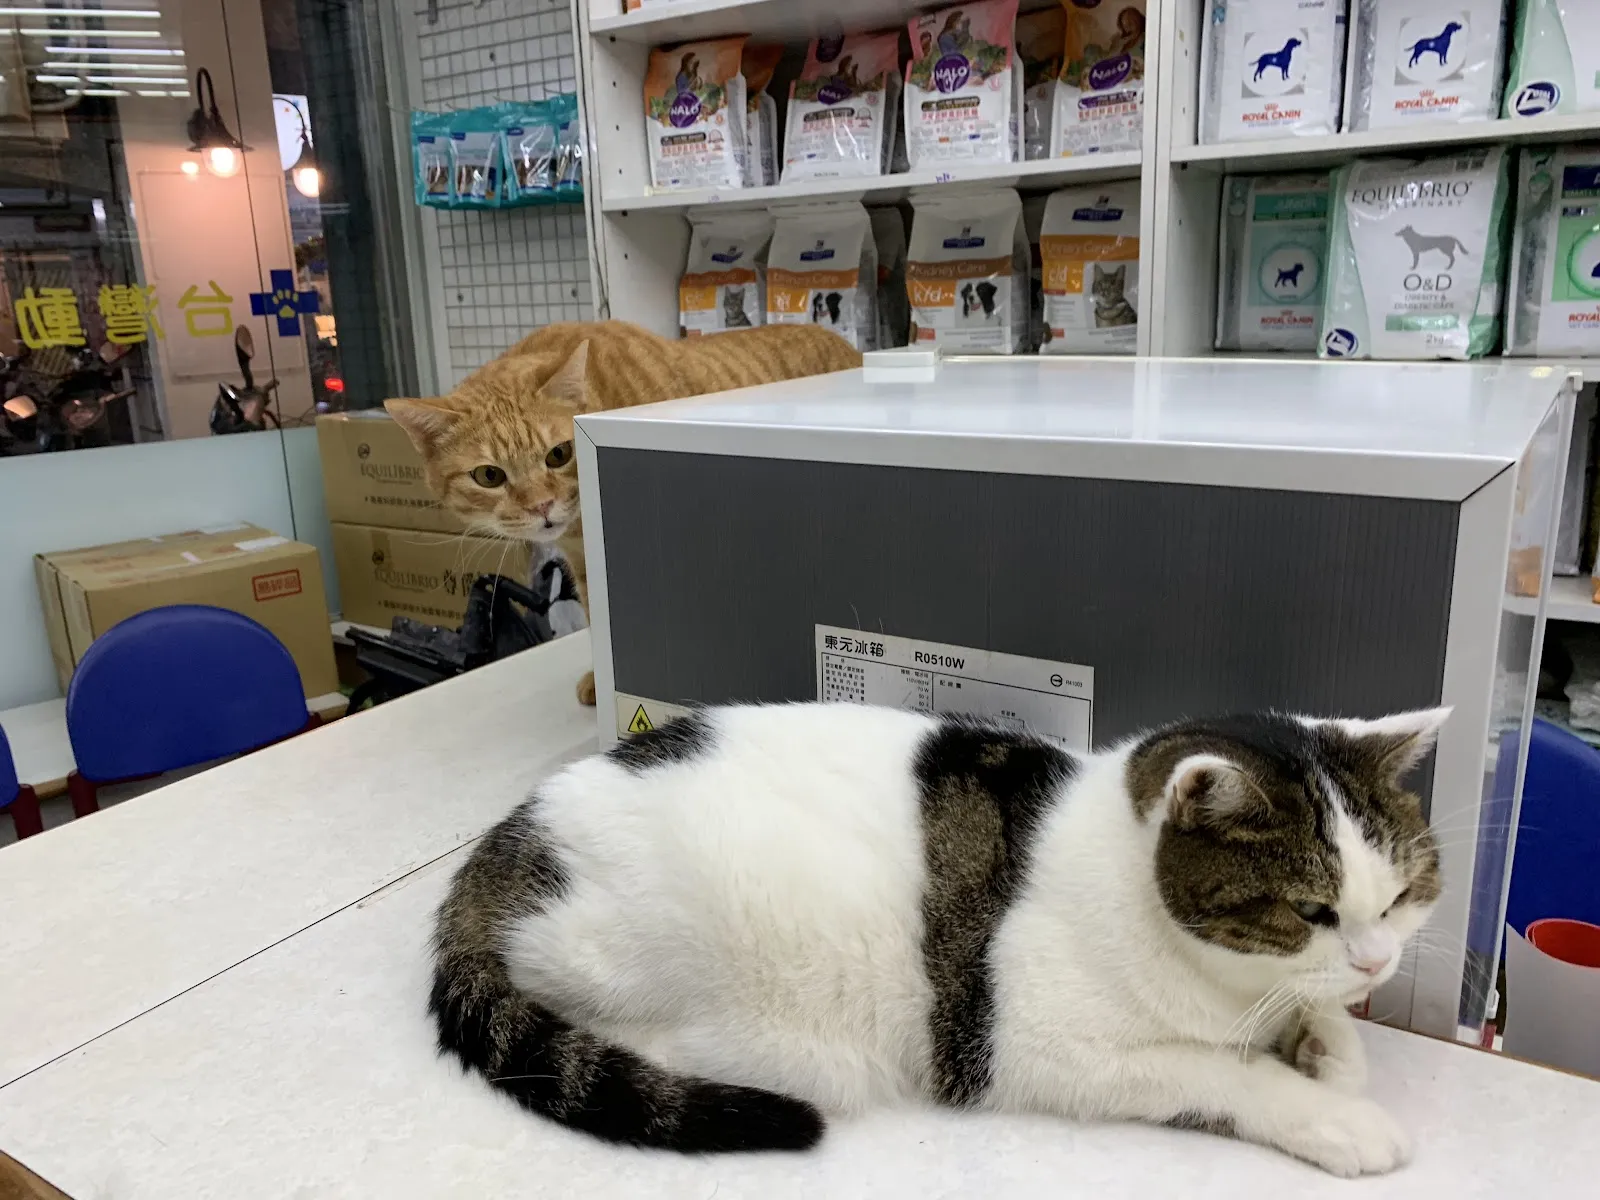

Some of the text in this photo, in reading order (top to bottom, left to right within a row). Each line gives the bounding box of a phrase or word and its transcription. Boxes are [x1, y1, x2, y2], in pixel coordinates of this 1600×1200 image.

[1395, 96, 1459, 109] ROYAL CANIN
[1242, 110, 1302, 122] ROYAL CANIN
[1403, 273, 1452, 291] O&D
[1261, 315, 1314, 325] ROYAL CANIN
[825, 635, 965, 670] 東元冰箱 R0510W
